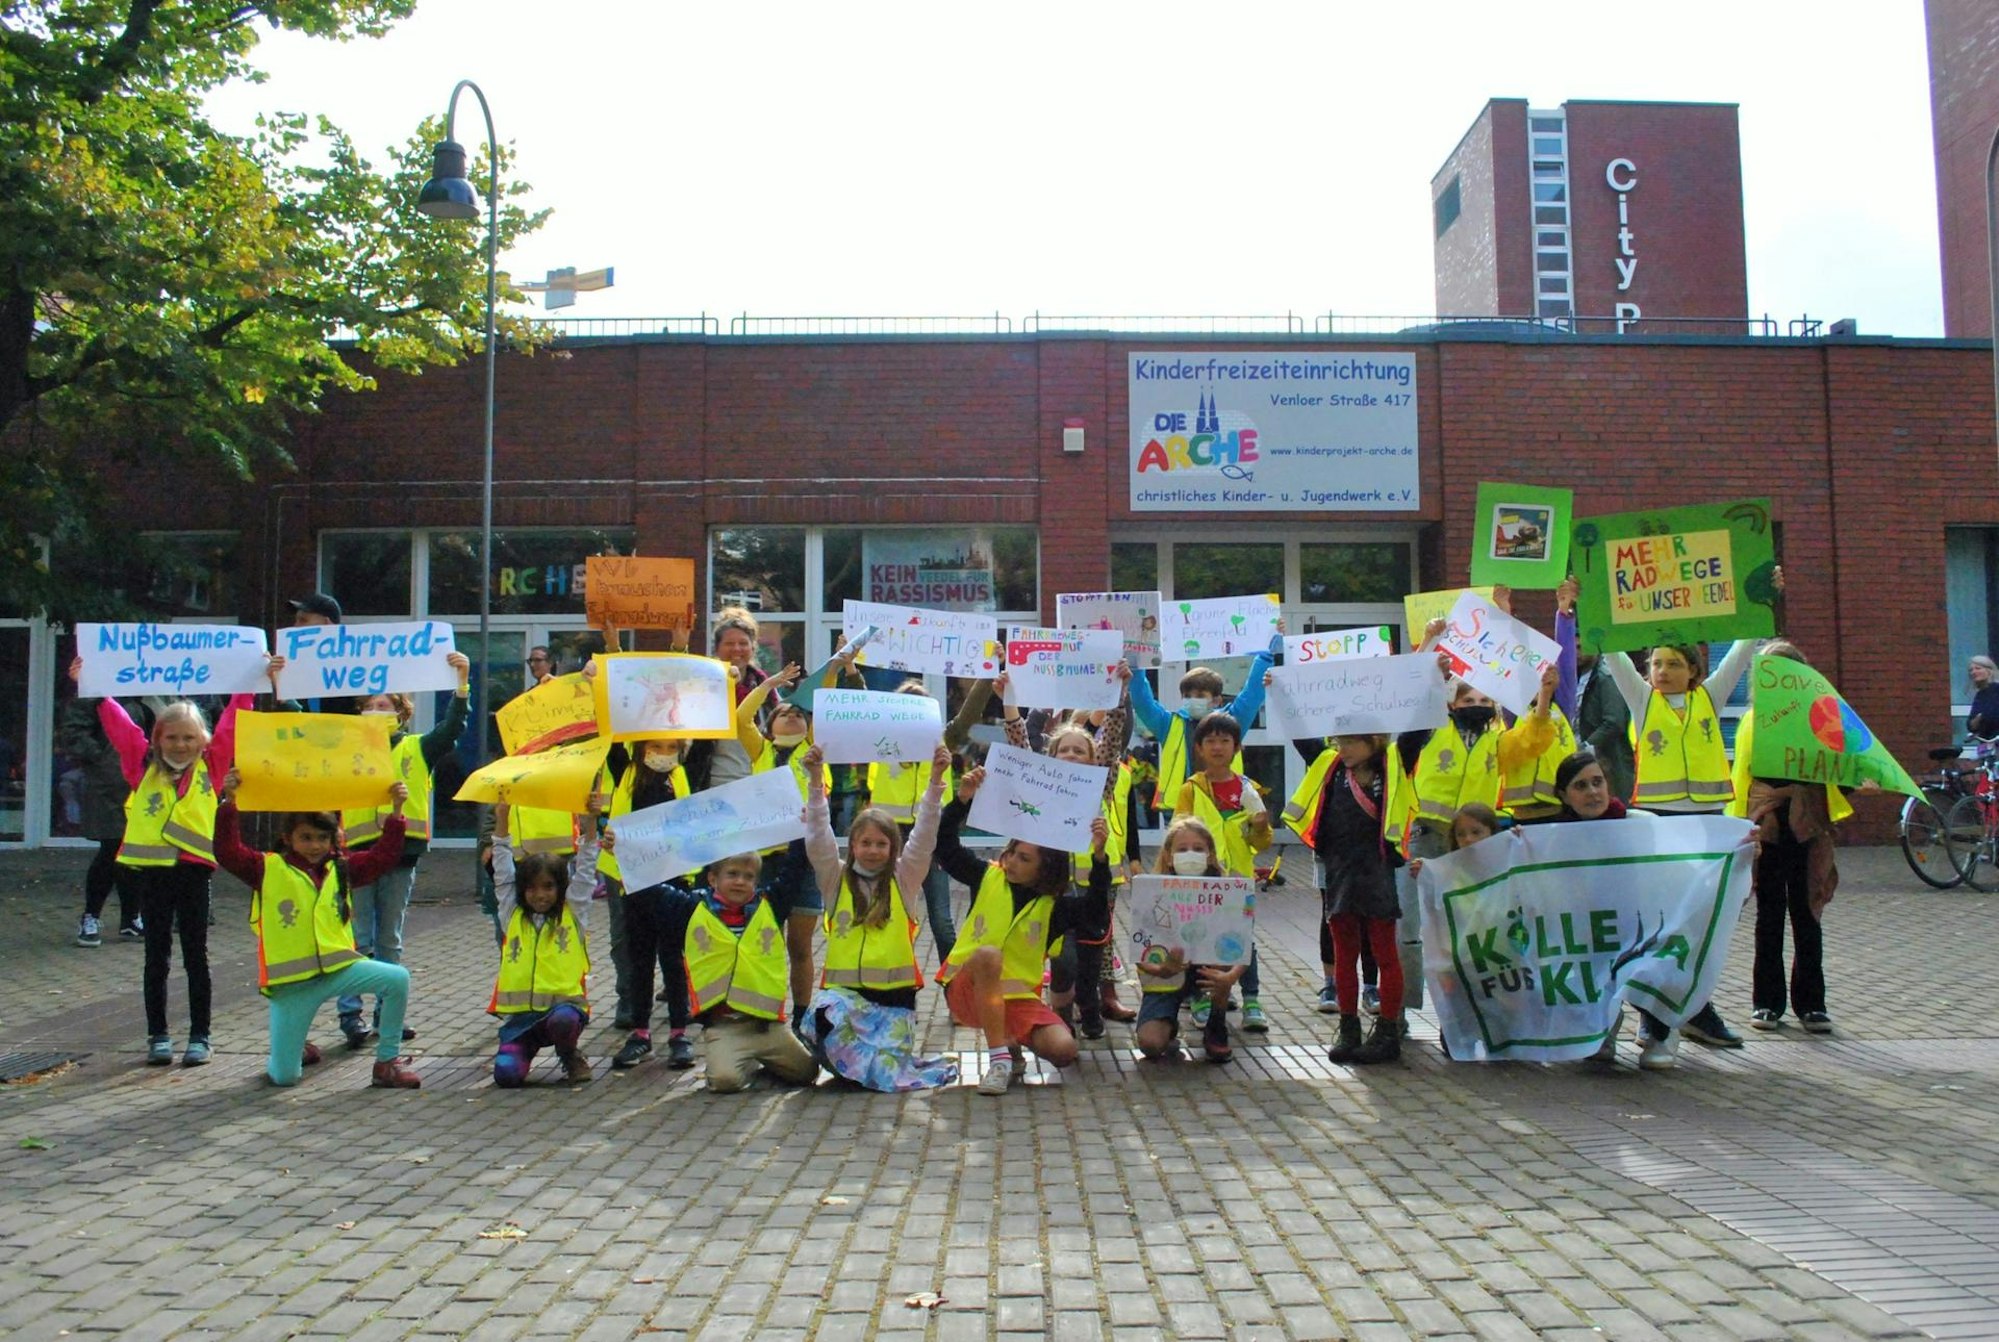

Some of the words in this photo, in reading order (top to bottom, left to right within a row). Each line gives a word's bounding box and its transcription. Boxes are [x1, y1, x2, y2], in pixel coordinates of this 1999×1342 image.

[1606, 158, 1638, 290] City
[1136, 359, 1410, 386] Kinderfreizeiteinrichtung
[1270, 394, 1323, 406] Venloer
[1329, 393, 1377, 406] Straße
[1384, 394, 1411, 406] 417
[1154, 413, 1187, 433] DIE
[1137, 429, 1260, 473] ARCHE
[1270, 447, 1413, 457] www.kinderprojekt-arche.de
[1137, 490, 1216, 502] christliches
[1223, 490, 1273, 502] Kinder-
[1300, 490, 1381, 504] Jugendwerk
[1616, 536, 1687, 569] MEHR
[871, 564, 917, 583] KEIN
[919, 571, 961, 582] VEEDEL
[1615, 557, 1722, 595] RADWEGE
[871, 583, 989, 603] RASSISMUS
[1640, 587, 1691, 613] UNSER
[99, 623, 256, 660] Nußbaumer-
[285, 622, 449, 660] Fahrrad-
[116, 657, 211, 692] straße
[322, 664, 389, 694] weg
[1759, 660, 1827, 694] Save
[825, 692, 868, 705] MEHR
[825, 710, 880, 721] FAHRRAD
[1467, 906, 1621, 973] KÖLLE
